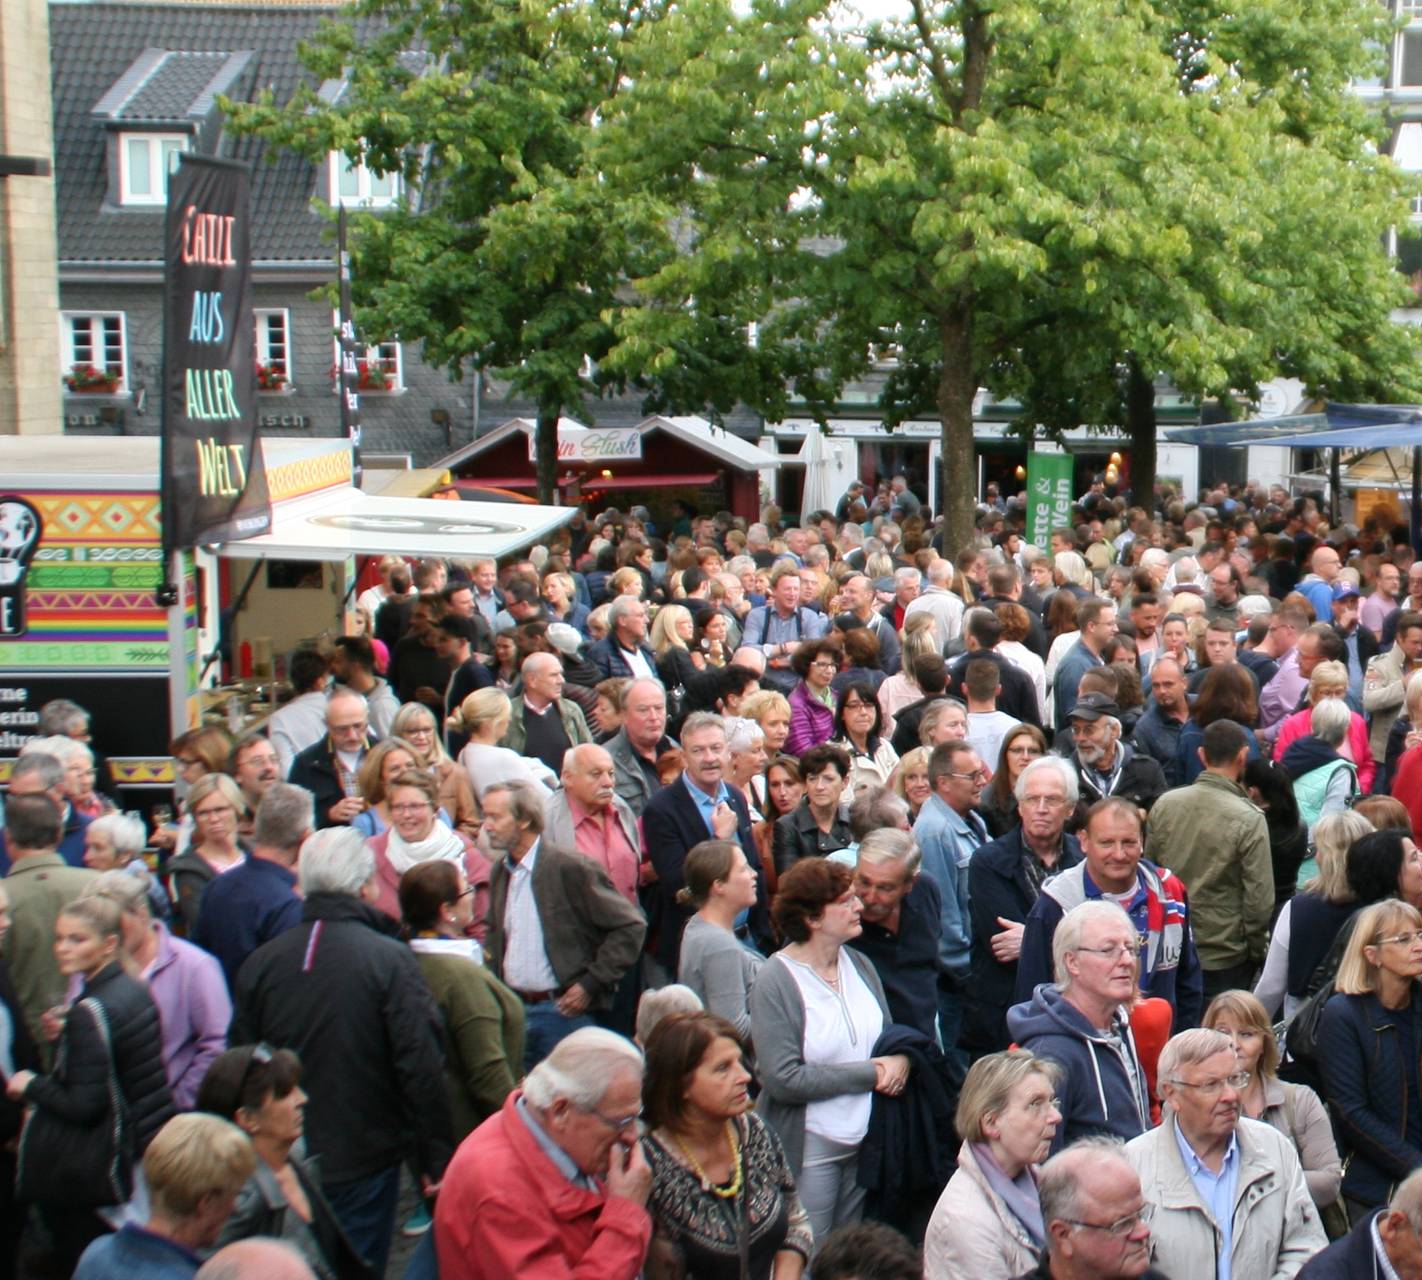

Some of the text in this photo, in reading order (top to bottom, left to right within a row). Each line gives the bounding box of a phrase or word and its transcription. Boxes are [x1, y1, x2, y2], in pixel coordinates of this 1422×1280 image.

[188, 290, 224, 343] AUS
[186, 367, 241, 419] ALLER
[196, 437, 247, 496] WELT
